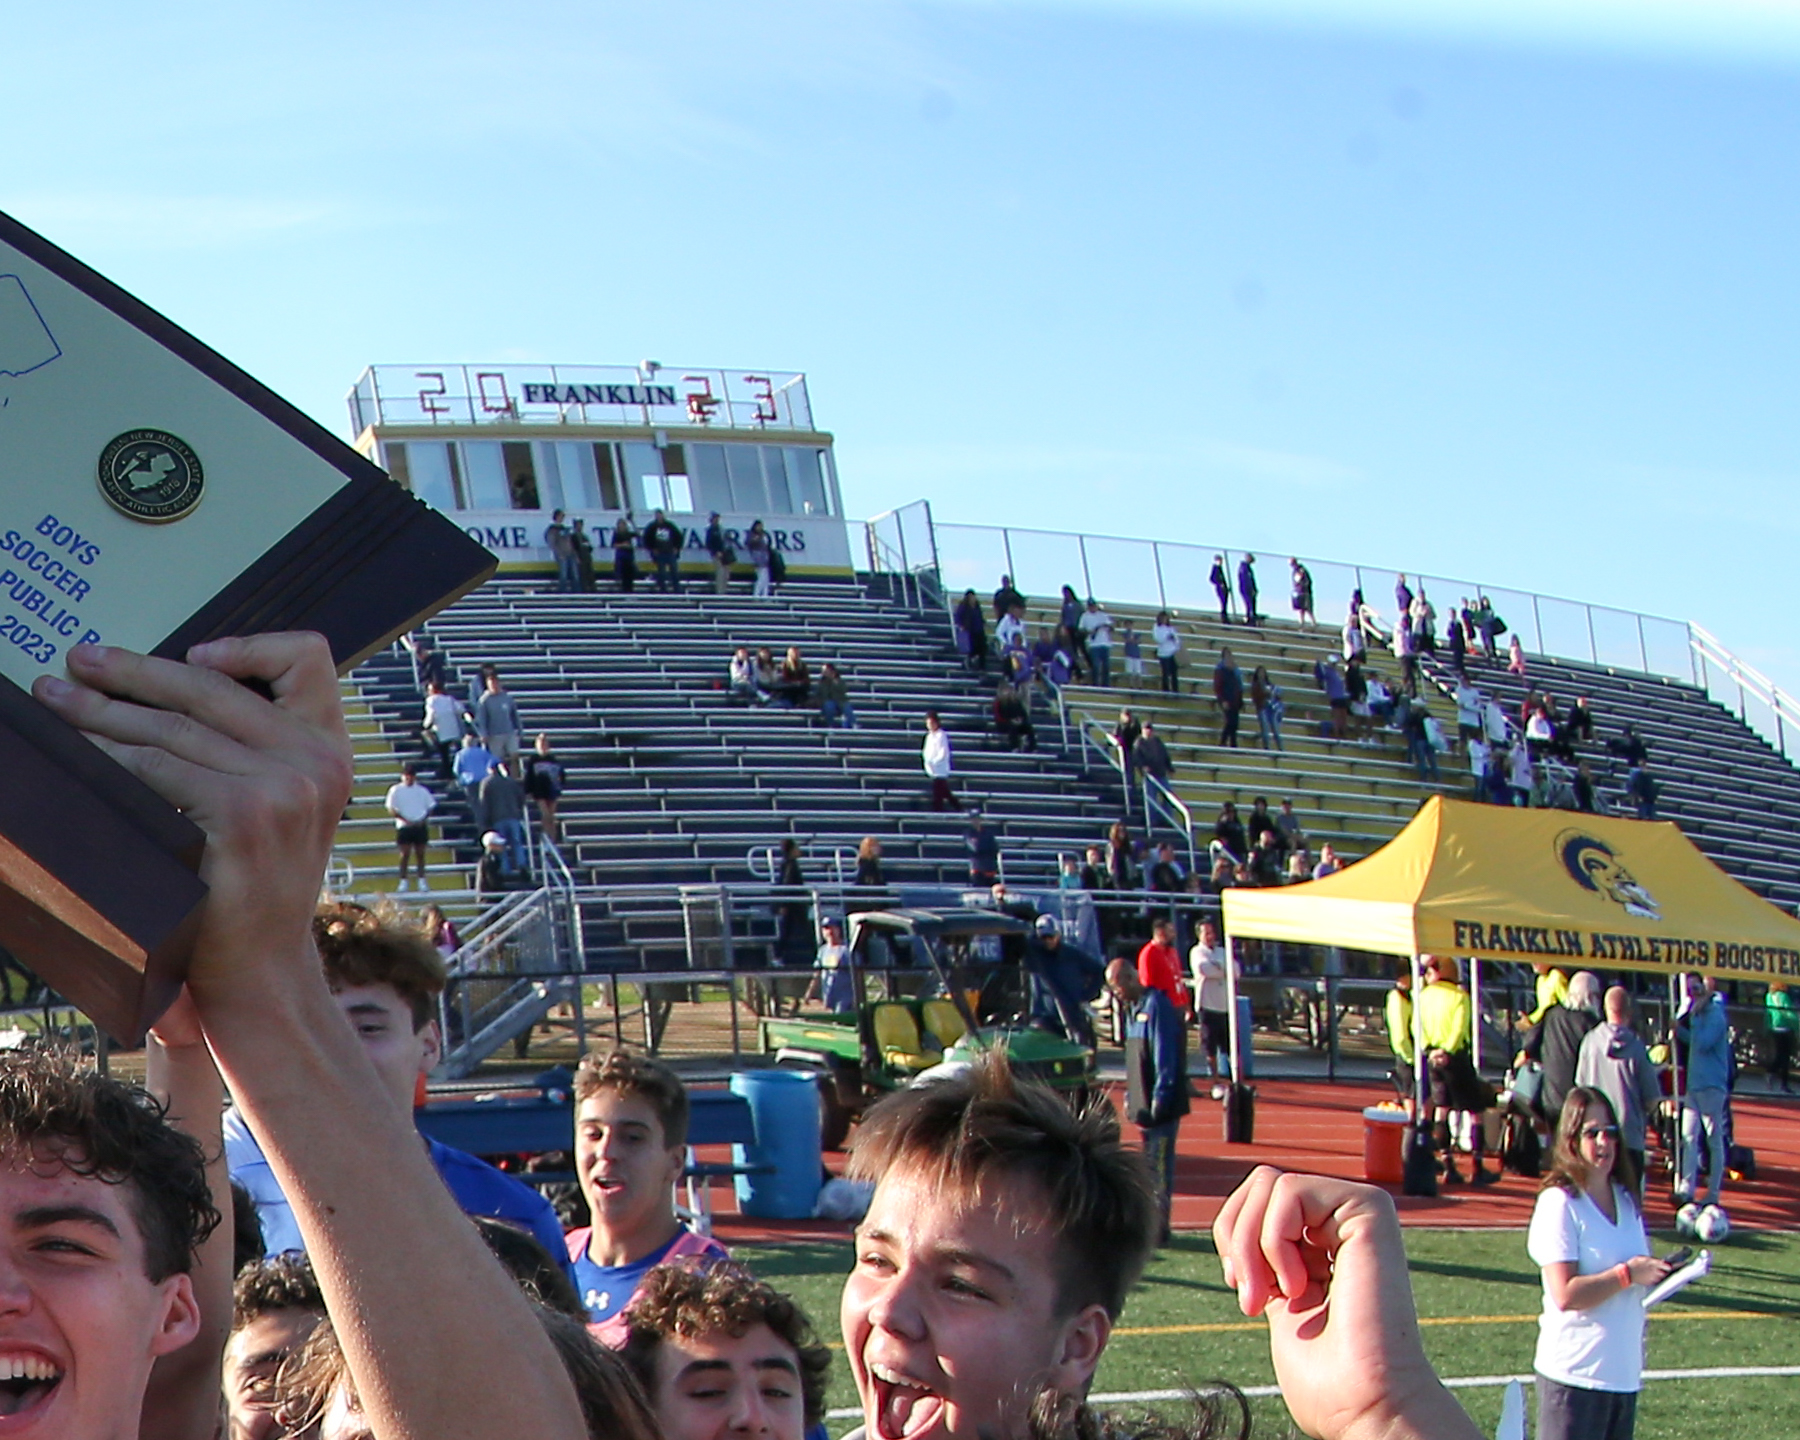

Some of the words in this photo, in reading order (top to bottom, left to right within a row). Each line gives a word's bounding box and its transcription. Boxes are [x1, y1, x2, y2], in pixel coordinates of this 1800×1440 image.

[522, 383, 676, 405] FRANKLIN
[34, 514, 101, 565] BOYS
[1453, 920, 1584, 957] FRANKLIN
[1590, 932, 1710, 967] ATHLETICS
